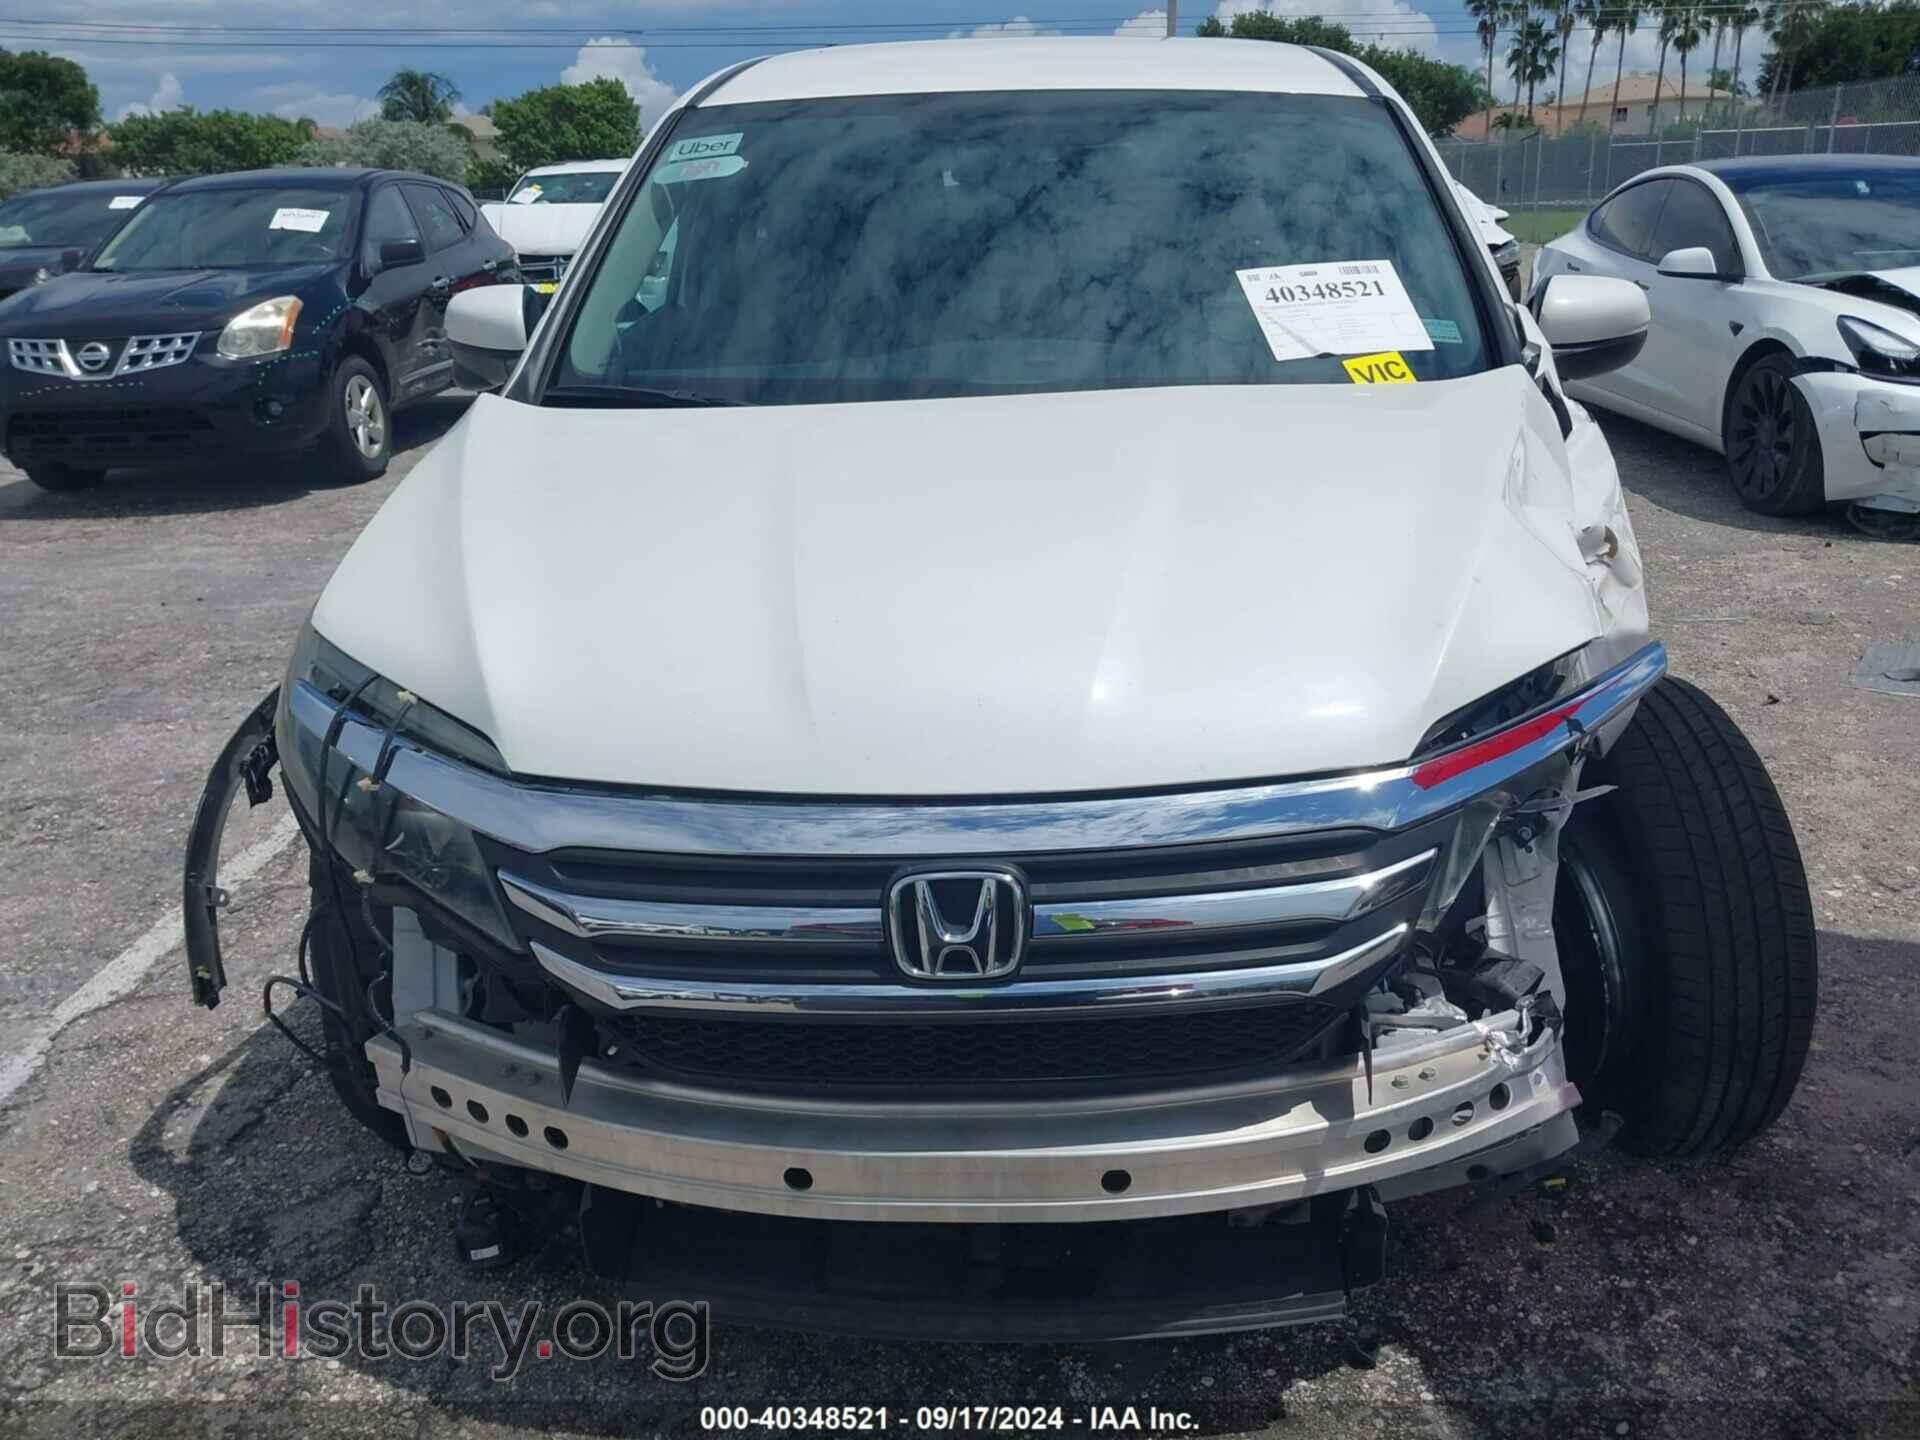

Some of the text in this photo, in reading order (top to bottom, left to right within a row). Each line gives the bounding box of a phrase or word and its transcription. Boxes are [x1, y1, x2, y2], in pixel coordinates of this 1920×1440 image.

[679, 140, 733, 155] Uber
[1265, 280, 1385, 303] 40348521
[1352, 360, 1407, 384] VIC
